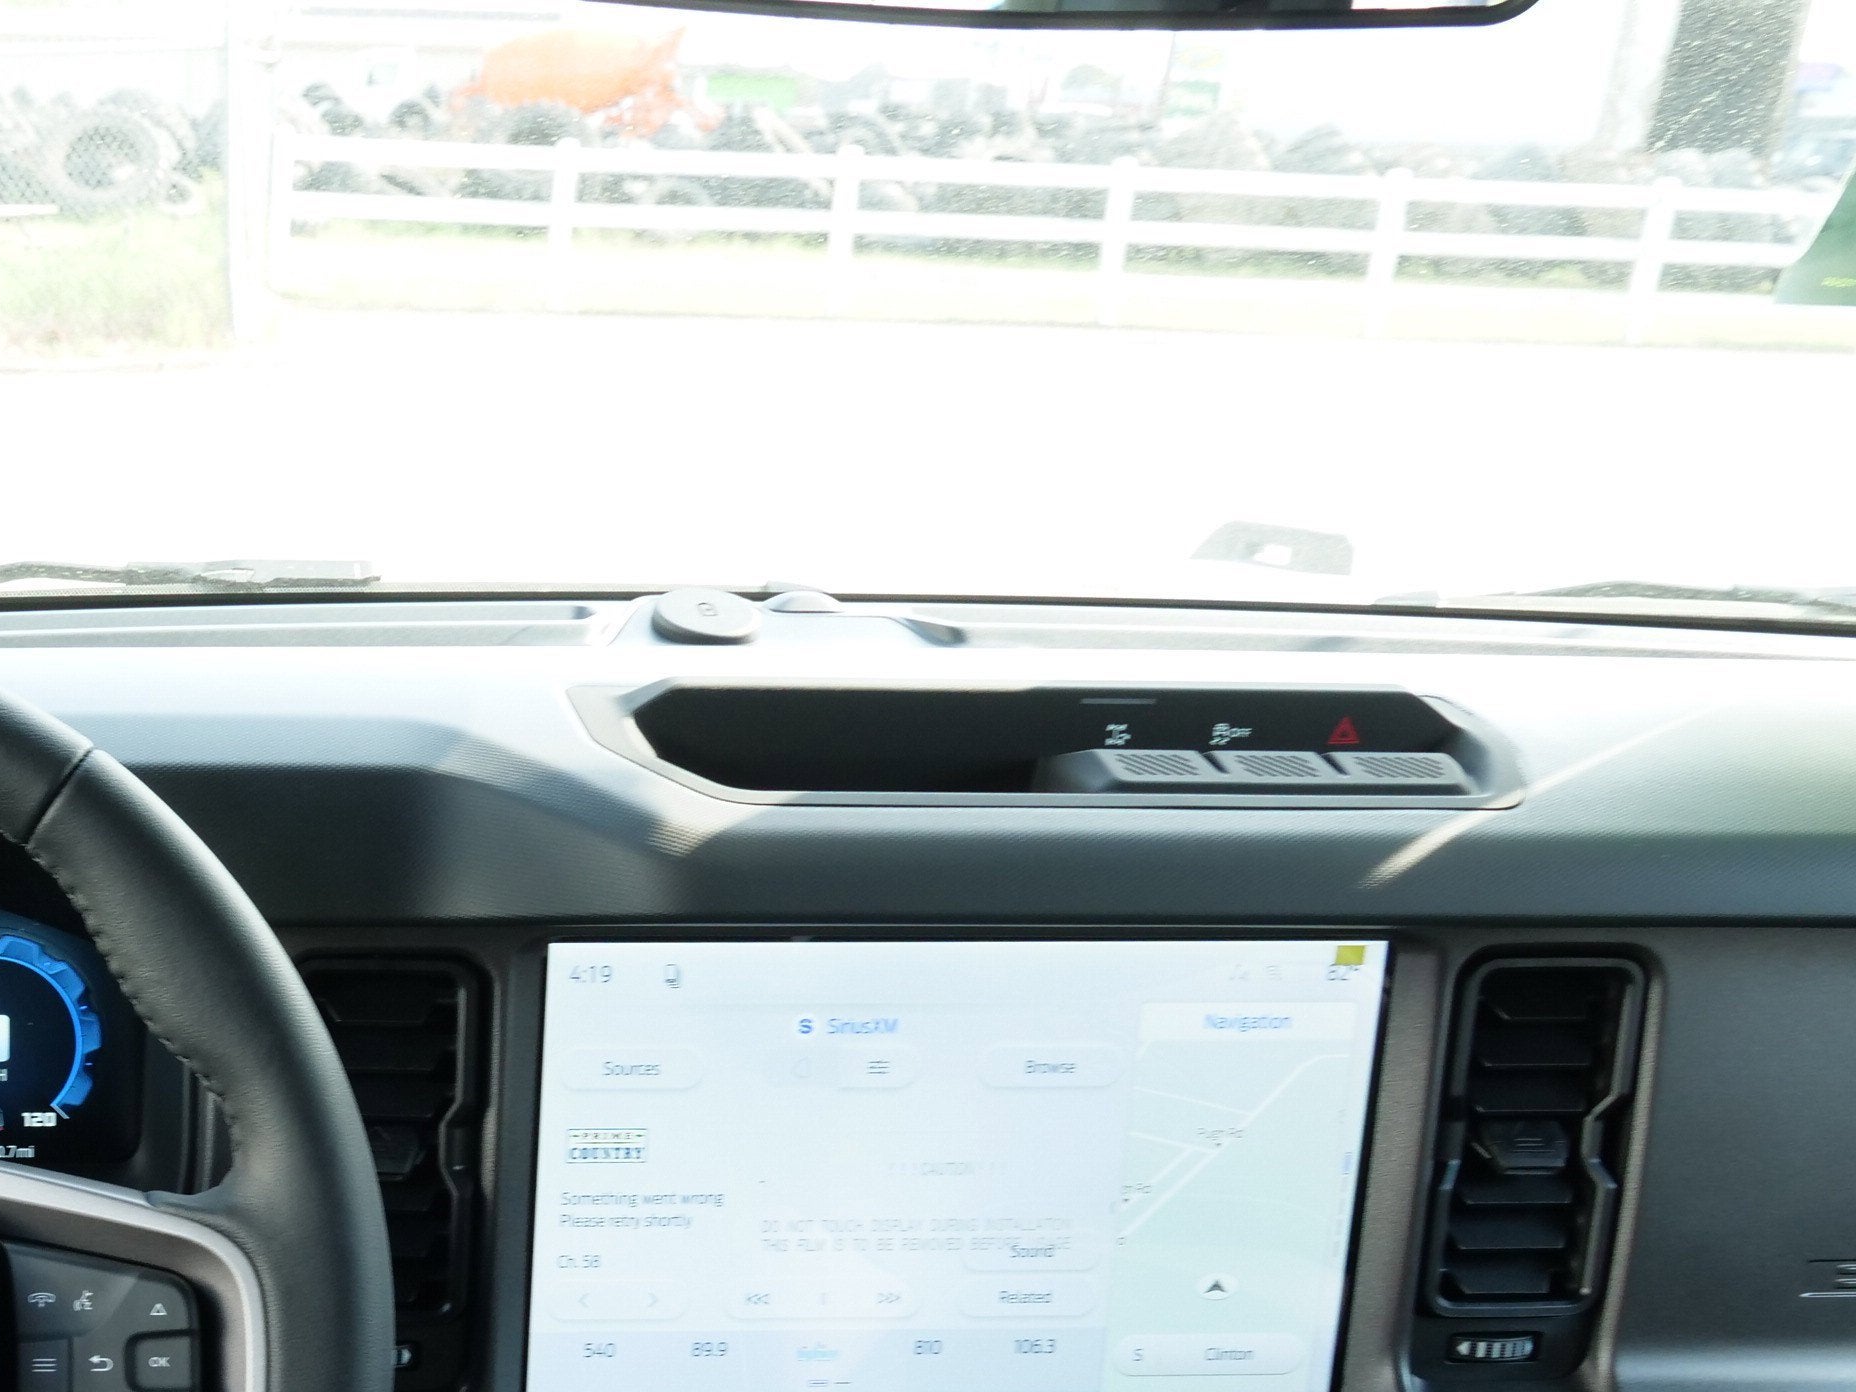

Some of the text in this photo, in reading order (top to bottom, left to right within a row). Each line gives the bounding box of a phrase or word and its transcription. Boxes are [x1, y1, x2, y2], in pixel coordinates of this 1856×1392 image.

[569, 965, 613, 983] 4:19
[1204, 1015, 1291, 1032] Navigation
[602, 1061, 661, 1076] Sources
[1025, 1060, 1076, 1075] Browse
[21, 1112, 57, 1127] 120
[568, 1146, 646, 1161] COUNTRY
[560, 1191, 724, 1208] Something went wrong
[559, 1213, 693, 1230] Please retry shortly
[999, 1290, 1052, 1304] Related
[583, 1343, 617, 1358] 540
[690, 1342, 728, 1357] 89.9
[914, 1340, 942, 1355] 810
[1014, 1339, 1056, 1354] 106.3
[148, 1356, 171, 1368] OK
